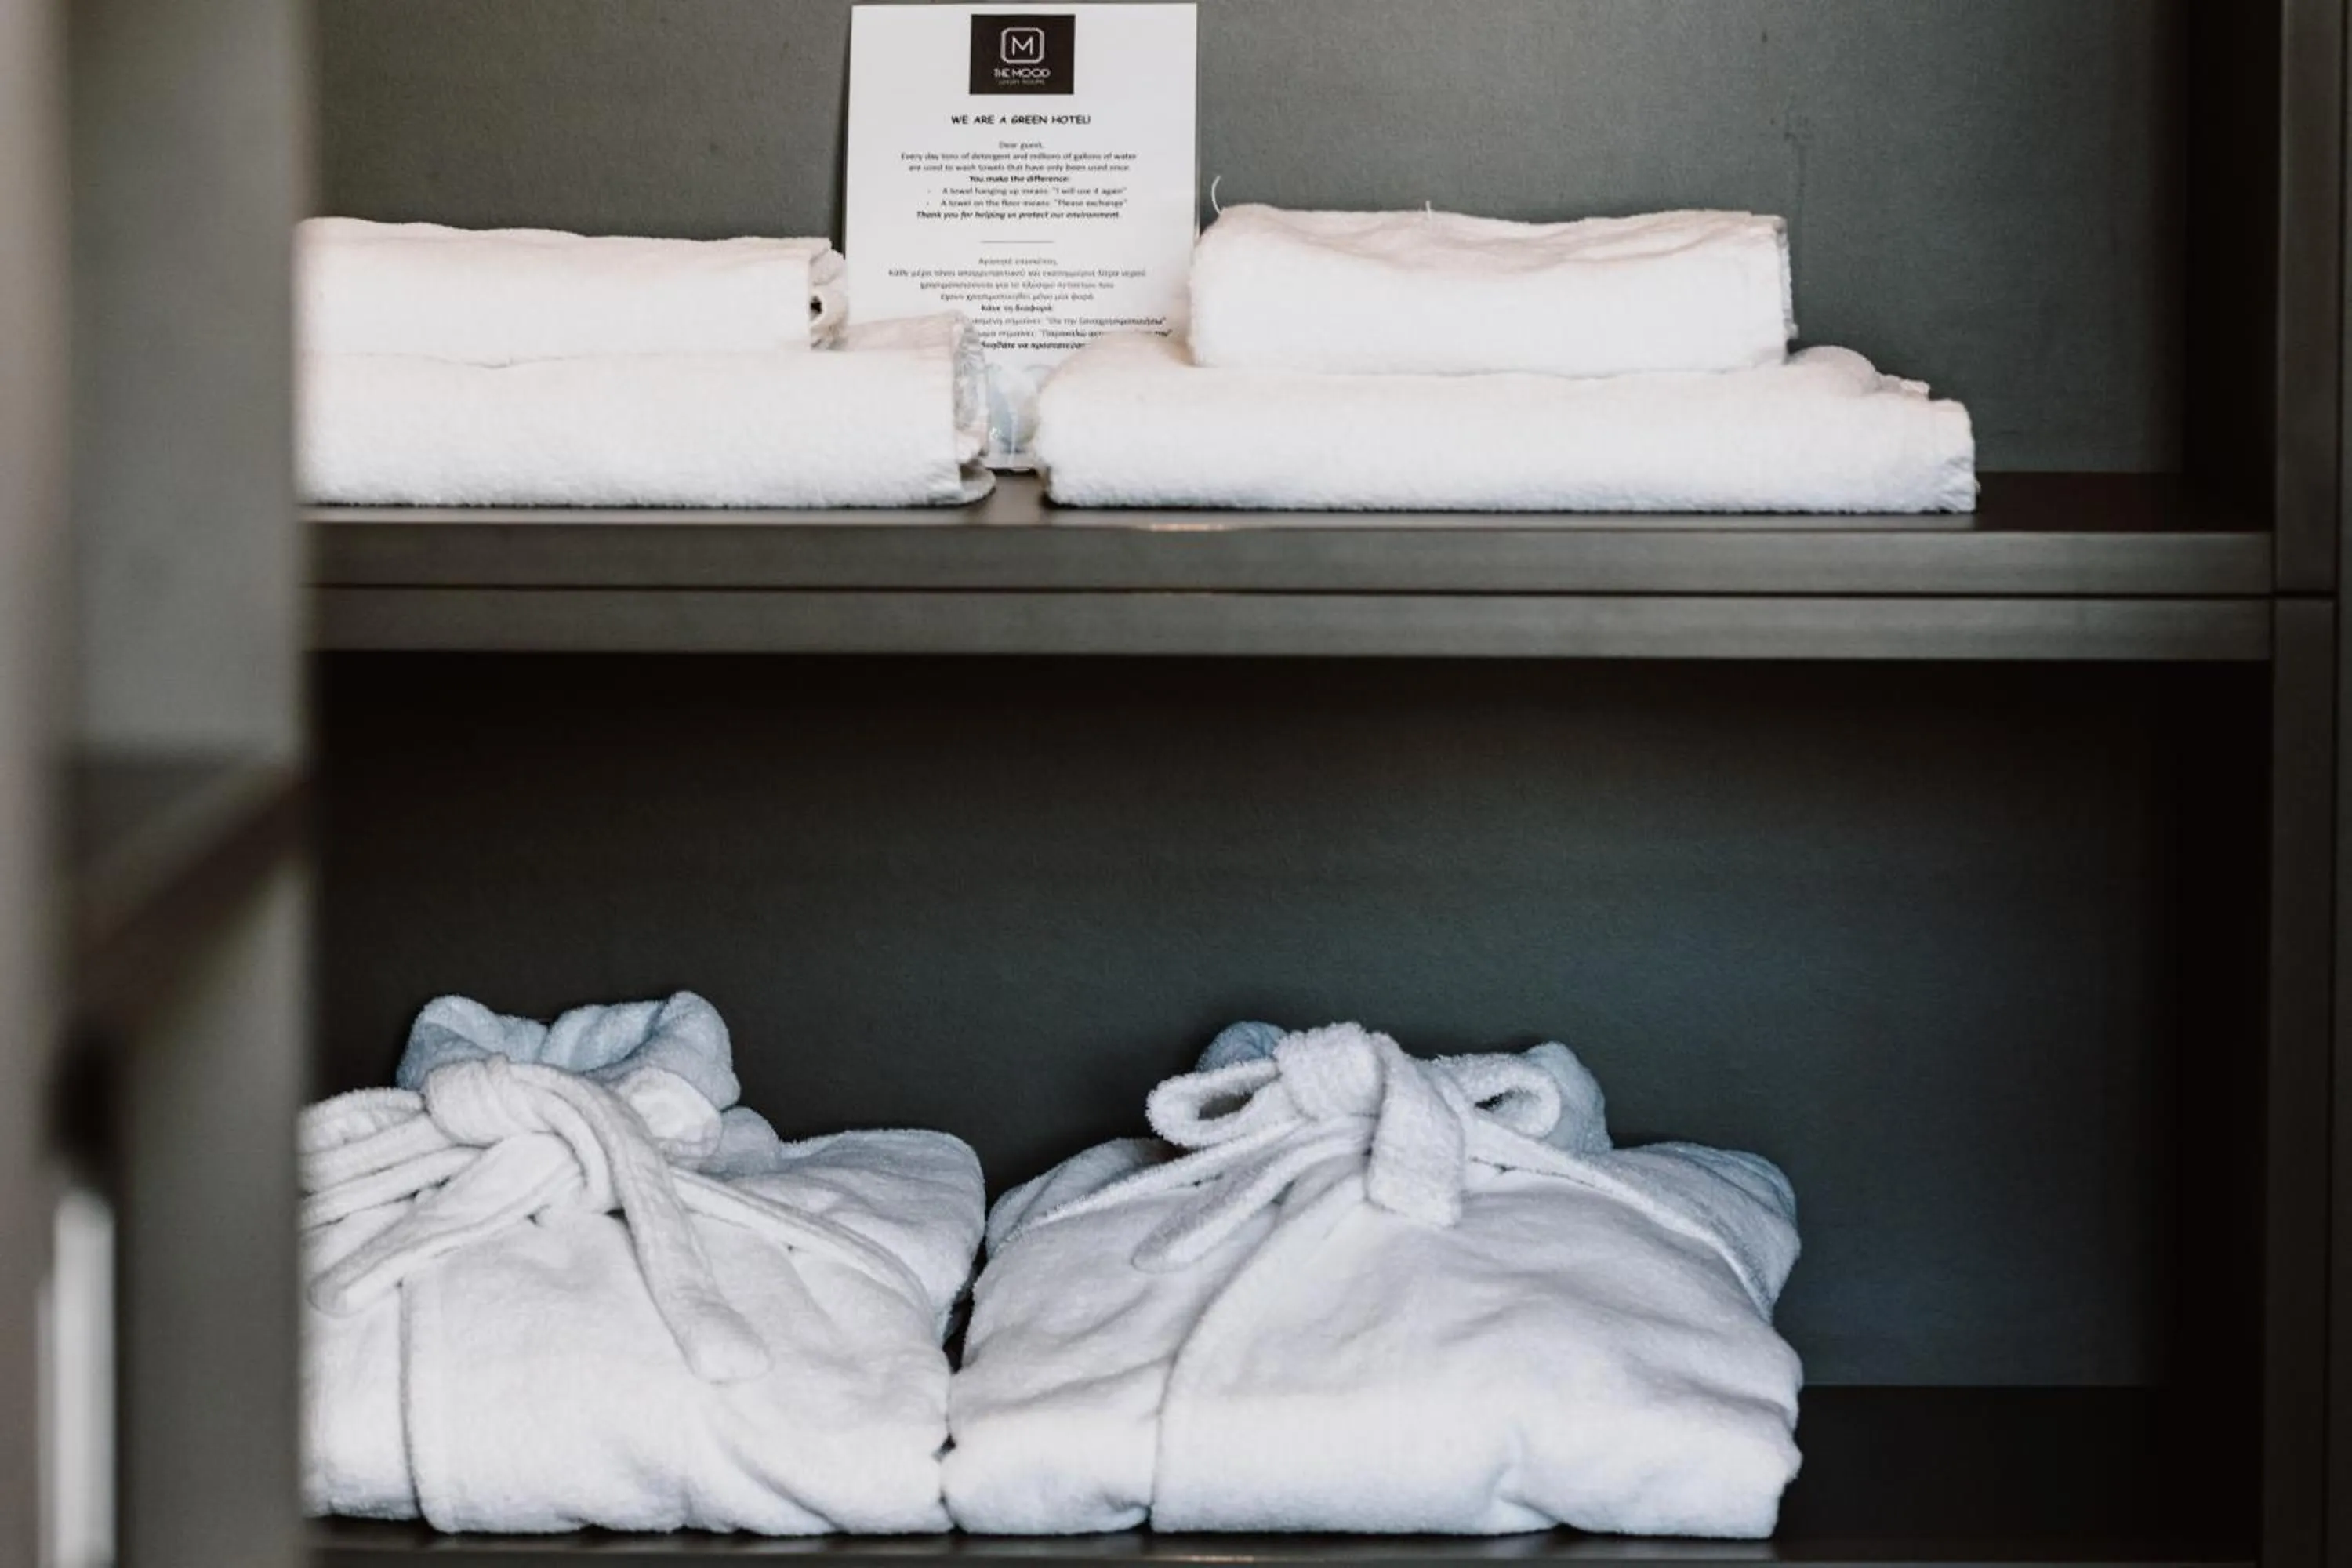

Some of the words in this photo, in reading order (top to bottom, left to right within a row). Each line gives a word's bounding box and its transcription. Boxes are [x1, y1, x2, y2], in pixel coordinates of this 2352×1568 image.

[1011, 35, 1034, 56] M
[993, 68, 1011, 78] THE
[1011, 68, 1051, 78] MOOD
[951, 114, 970, 125] WE
[972, 114, 995, 125] ARE
[1011, 114, 1049, 125] GREEN
[1051, 114, 1091, 125] HOTEL!
[901, 152, 923, 161] Every
[924, 152, 939, 161] day
[971, 152, 1010, 161] detergent
[1073, 152, 1102, 162] gallons
[1065, 163, 1086, 172] been
[1087, 163, 1109, 172] used
[975, 187, 1007, 196] hanging
[916, 210, 942, 220] Thank
[960, 210, 974, 220] for
[975, 211, 1006, 220] helping
[1018, 211, 1049, 220] protect
